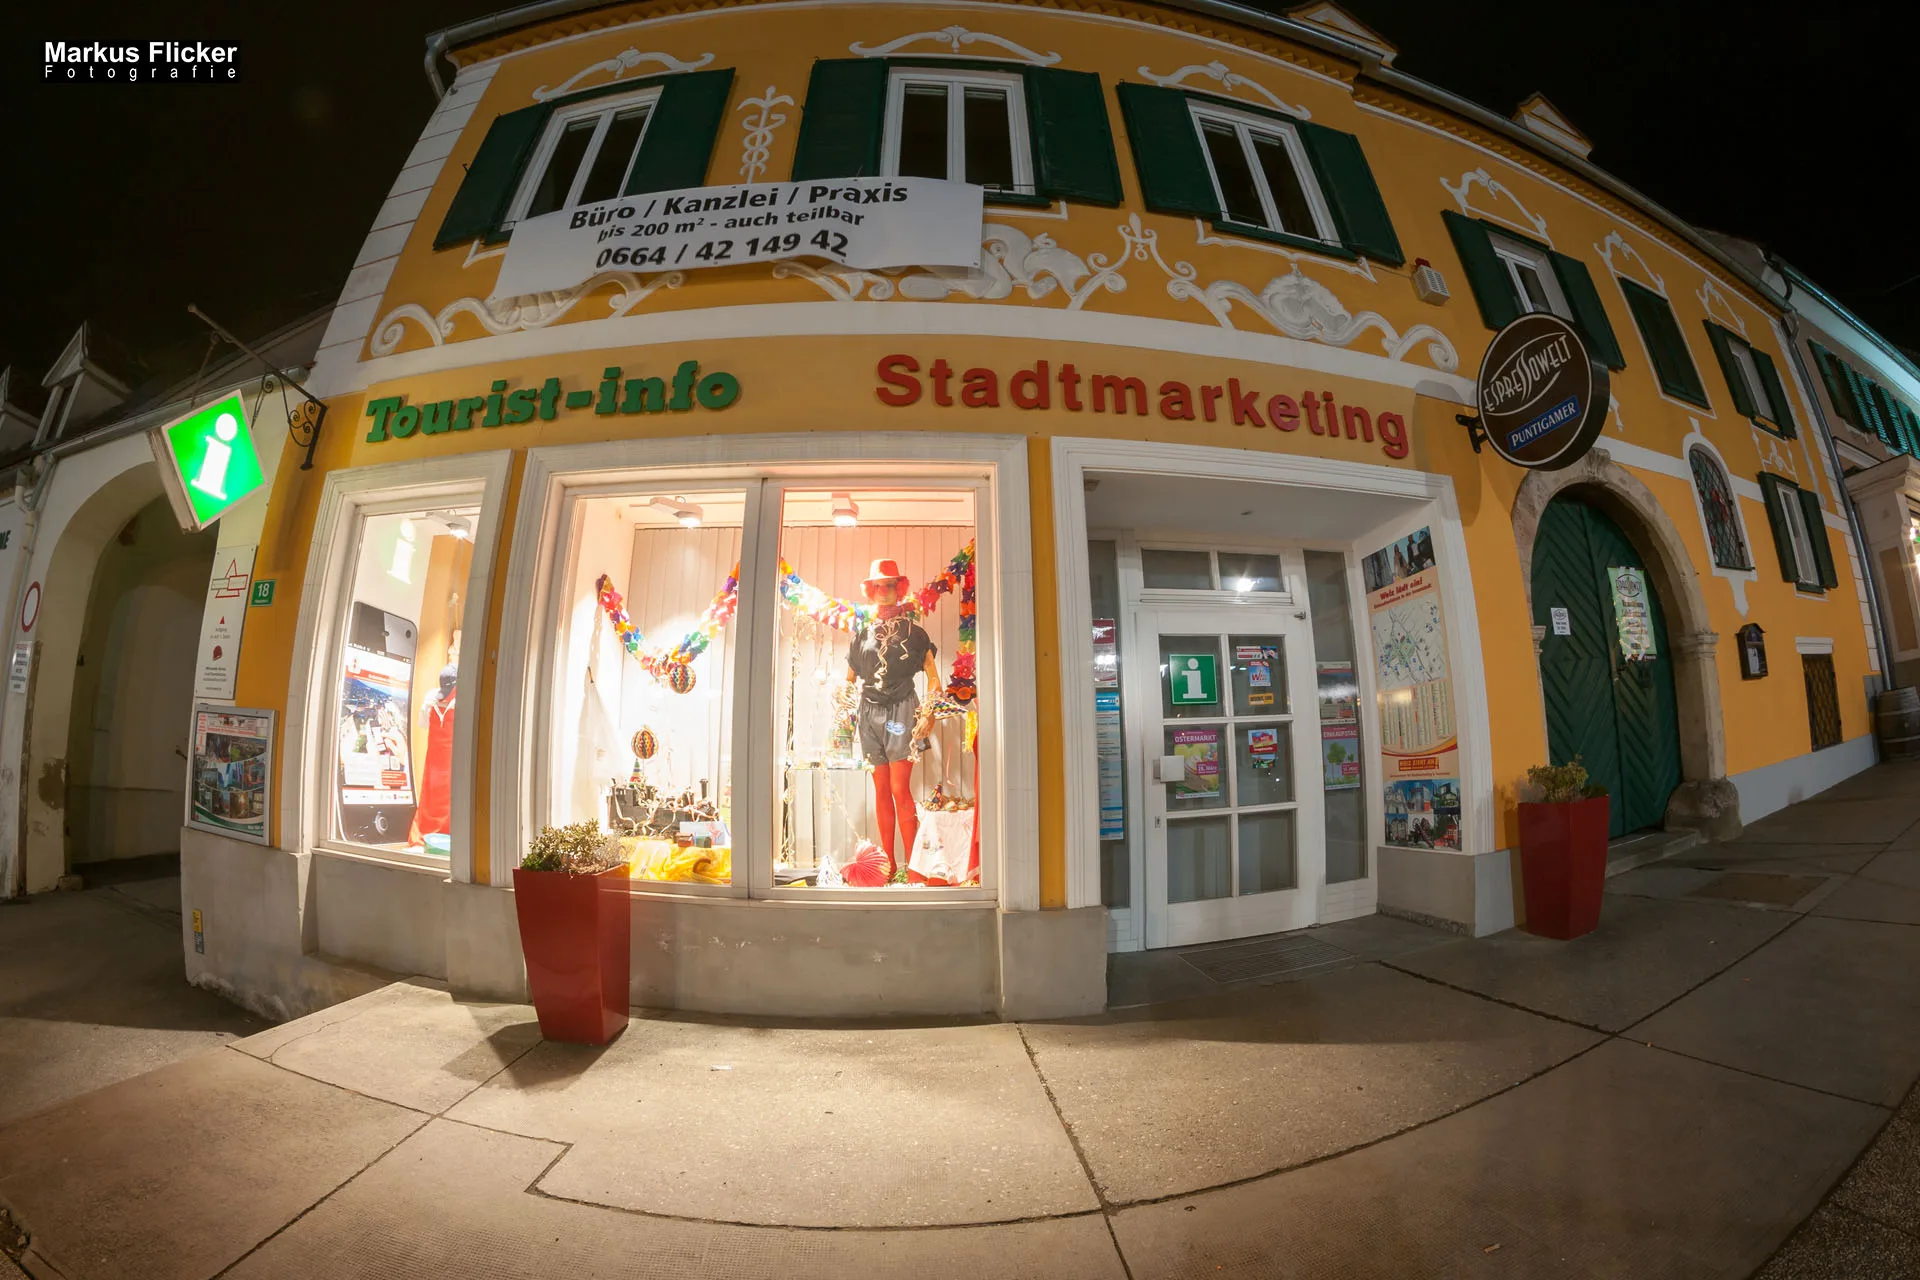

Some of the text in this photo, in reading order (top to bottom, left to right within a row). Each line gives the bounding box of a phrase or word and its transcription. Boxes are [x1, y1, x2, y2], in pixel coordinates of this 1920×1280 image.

[569, 203, 636, 231] Büro
[662, 188, 778, 217] Kanzlei
[809, 182, 908, 204] Praxis
[597, 225, 625, 243] bis
[630, 223, 669, 238] 200
[724, 212, 779, 229] auch
[785, 205, 865, 227] teilbar
[596, 245, 667, 269] 0664
[695, 238, 735, 261] 42
[746, 232, 801, 256] 149
[809, 229, 849, 257] 42
[1483, 335, 1572, 412] ESPRESSOWELT
[366, 360, 741, 443] Tourist-info
[876, 354, 1410, 459] Stadtmarketing
[1511, 402, 1576, 447] PUNTIGAMER
[258, 583, 270, 597] 18
[1174, 734, 1217, 743] OSTERMARKT
